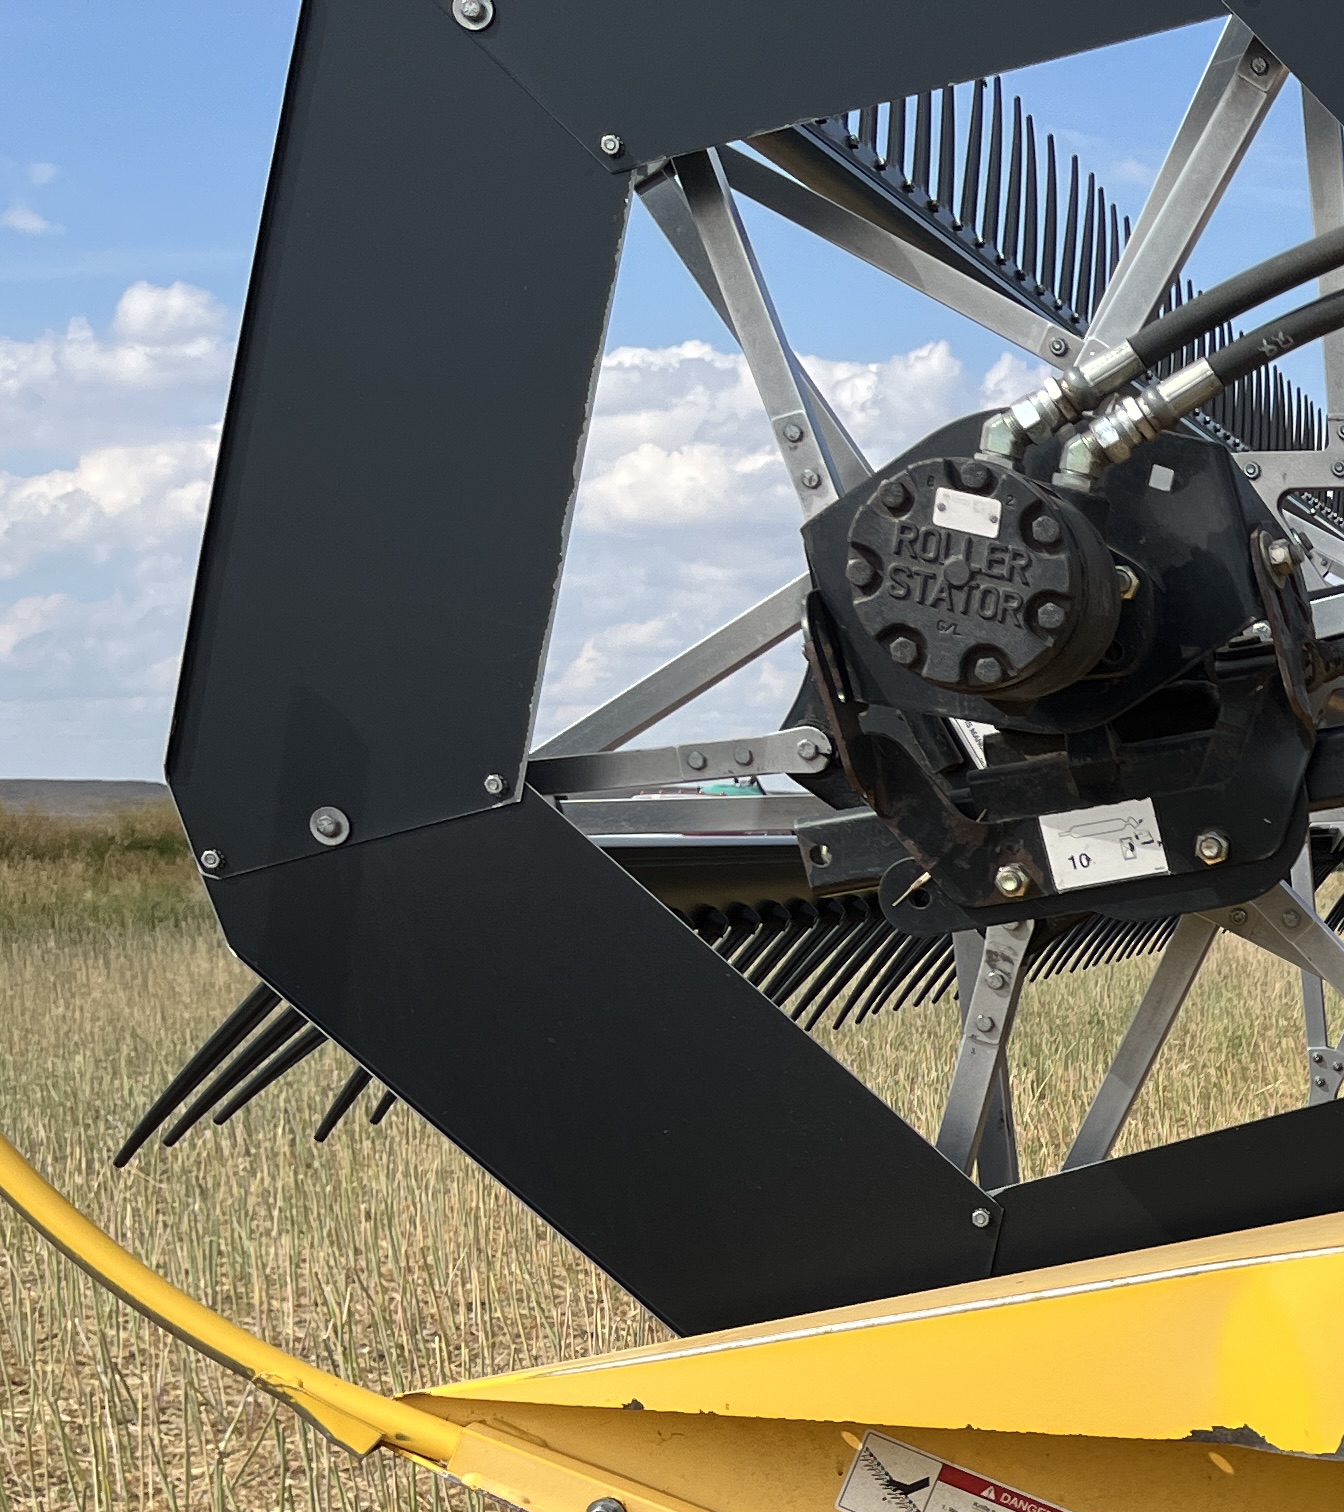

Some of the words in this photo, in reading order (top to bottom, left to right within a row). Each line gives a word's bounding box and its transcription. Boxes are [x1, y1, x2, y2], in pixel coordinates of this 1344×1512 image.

[893, 523, 1032, 587] ROLLER
[889, 563, 1024, 629] STATOR
[1068, 852, 1091, 870] 10
